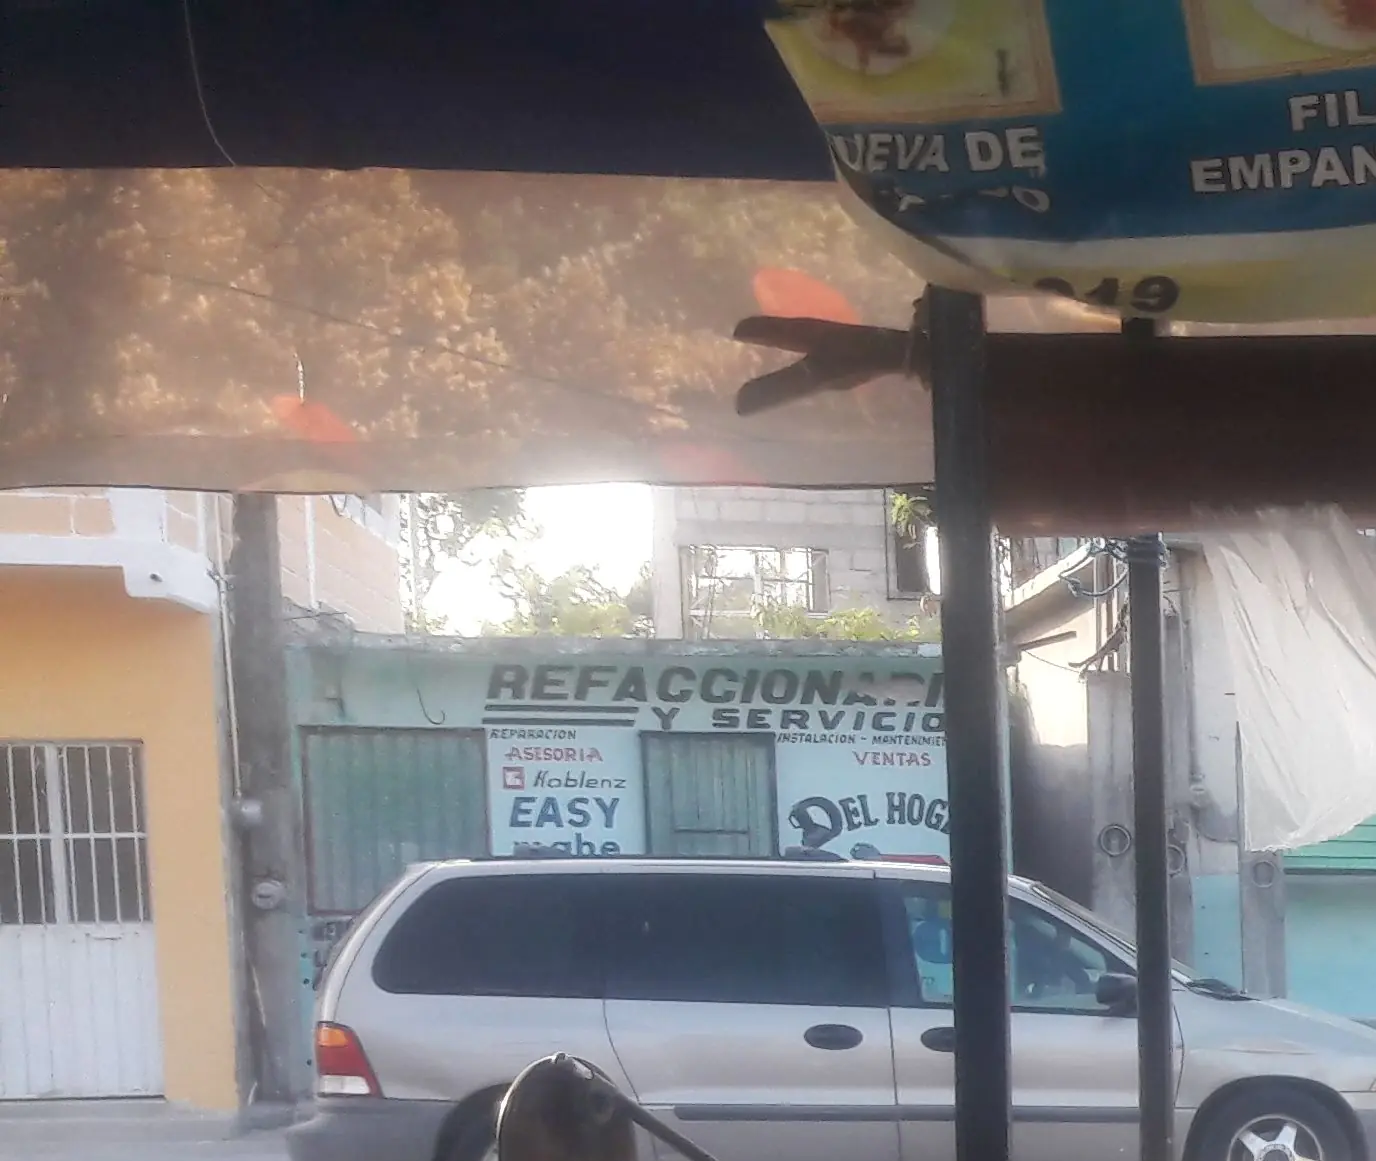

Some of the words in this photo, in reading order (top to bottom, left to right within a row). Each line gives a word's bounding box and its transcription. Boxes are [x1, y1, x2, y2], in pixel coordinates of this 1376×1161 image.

[833, 132, 950, 173] UEVA
[965, 126, 1045, 174] DE
[651, 707, 681, 731] Y
[490, 728, 577, 740] REPARACION
[777, 733, 855, 744] INSTALACION
[504, 746, 604, 762] ASESORIA
[852, 751, 931, 767] VENTAS
[533, 769, 627, 789] Koblenz
[509, 796, 620, 829] EASY
